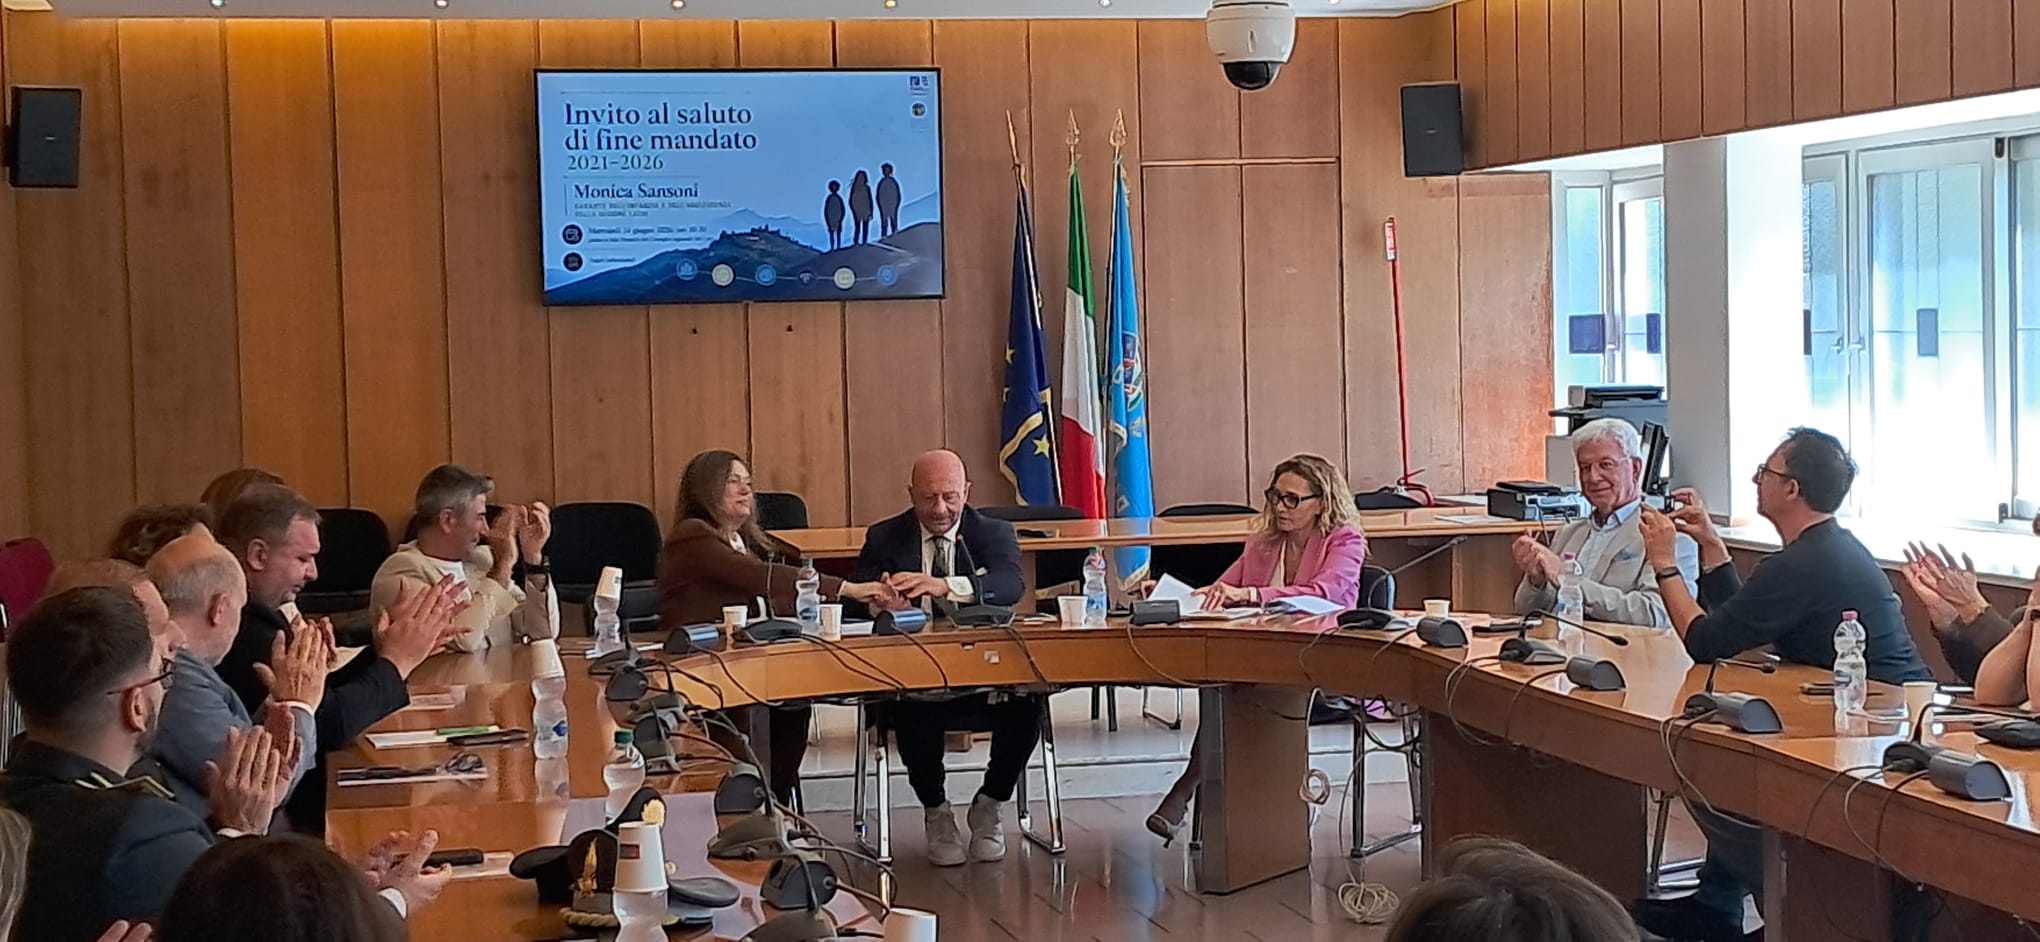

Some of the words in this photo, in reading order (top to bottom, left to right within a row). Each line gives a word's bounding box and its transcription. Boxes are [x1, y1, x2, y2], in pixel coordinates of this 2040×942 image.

[565, 102, 640, 125] Invito
[647, 102, 669, 125] al
[677, 102, 752, 125] saluto
[565, 128, 588, 150] di
[597, 128, 643, 150] fine
[651, 128, 757, 150] mandato
[574, 183, 633, 199] Monica
[638, 182, 699, 198] Sansoni
